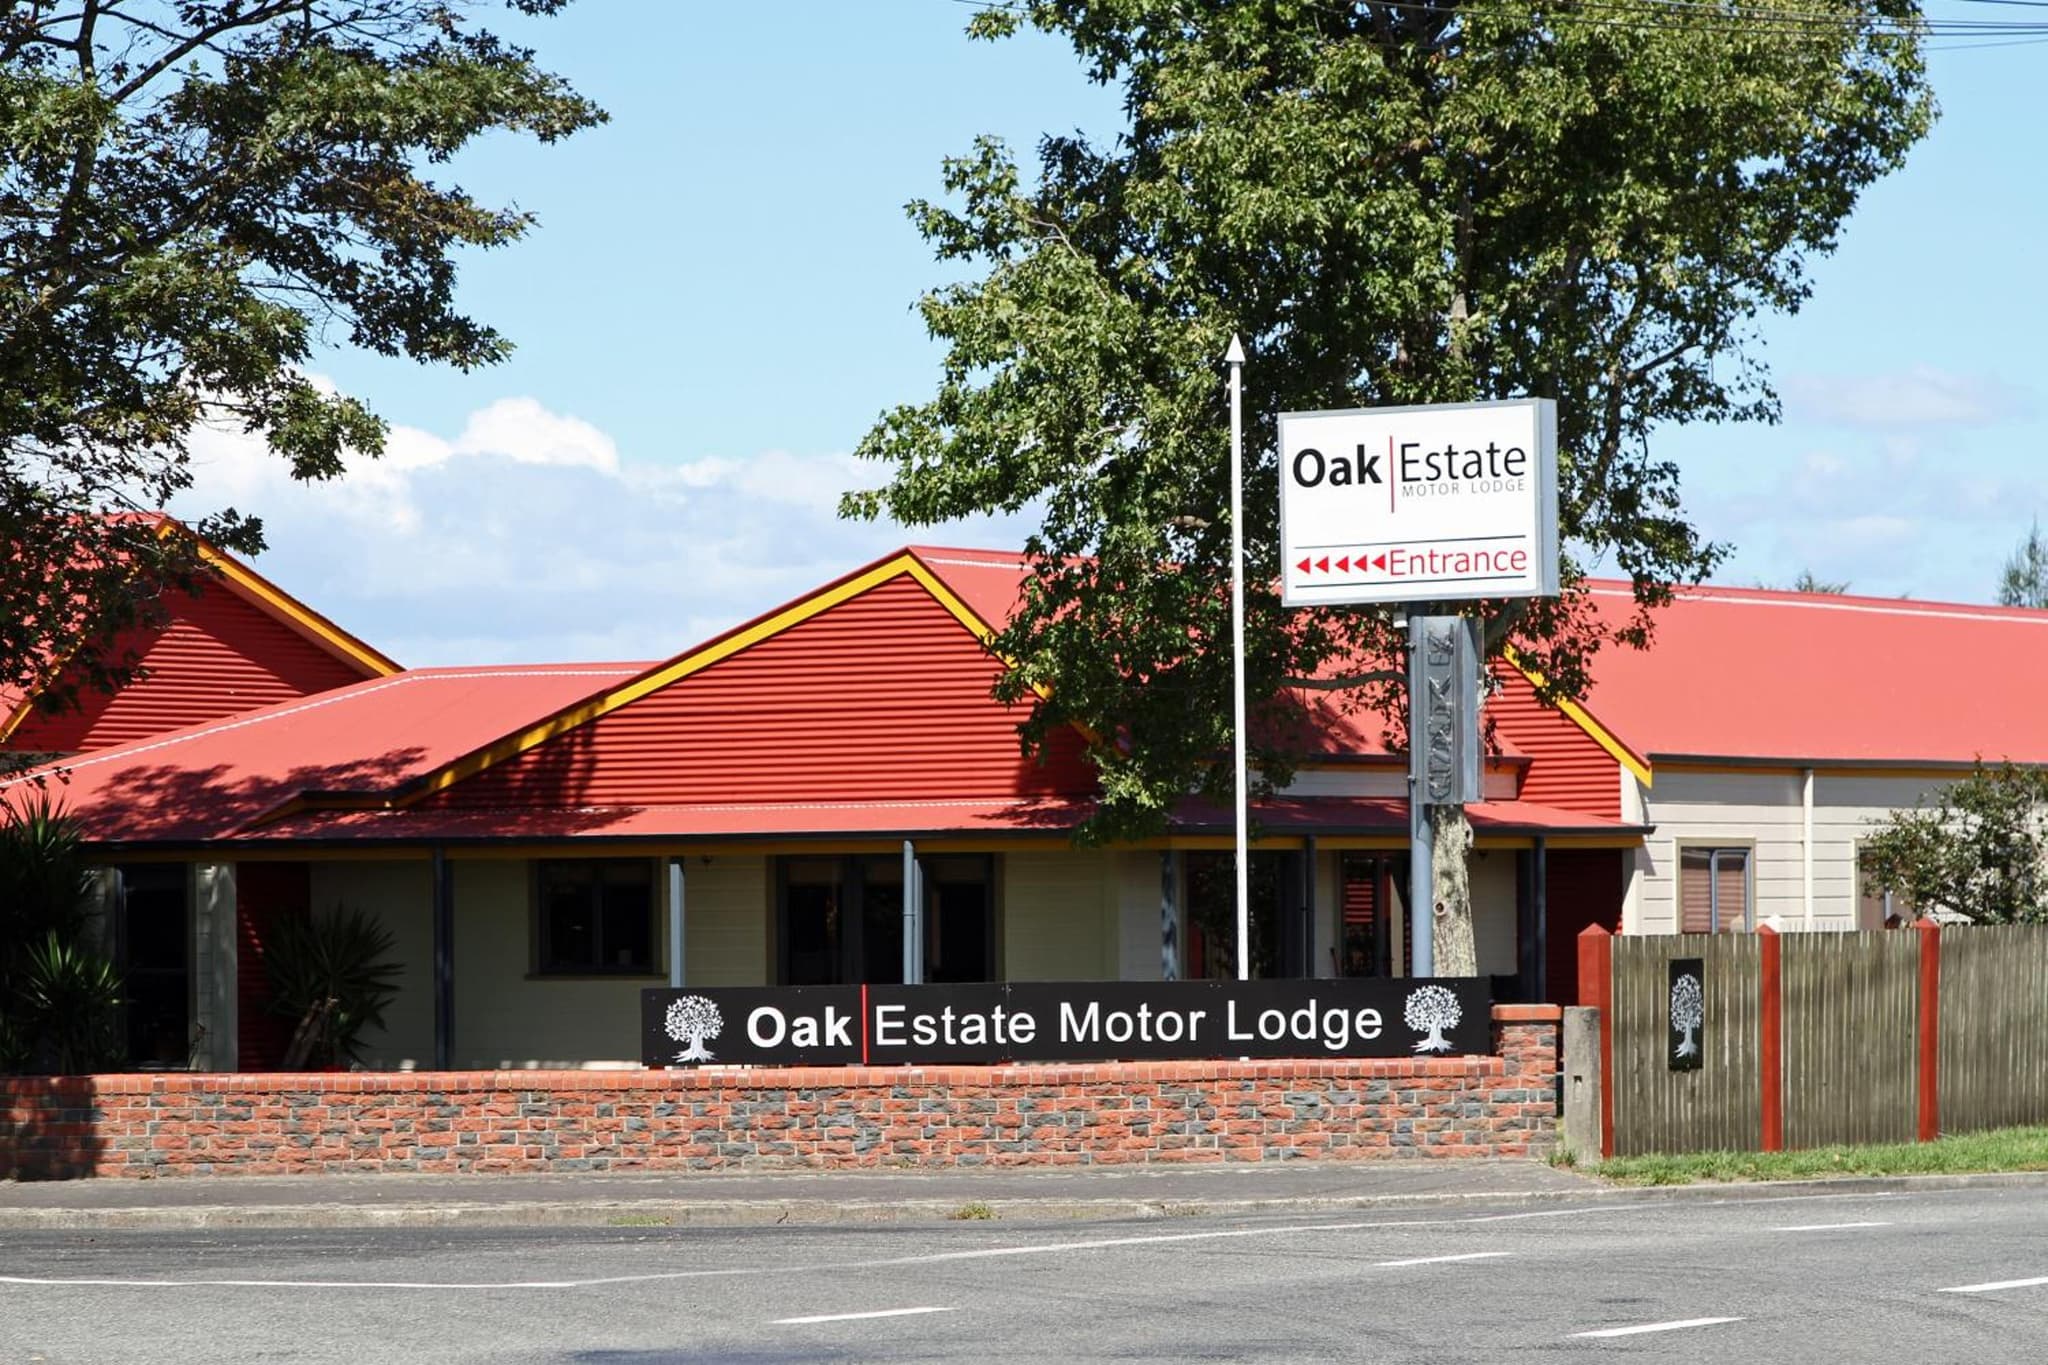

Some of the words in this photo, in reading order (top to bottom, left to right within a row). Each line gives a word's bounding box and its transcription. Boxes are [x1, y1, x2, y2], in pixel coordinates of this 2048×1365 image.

[1294, 444, 1383, 488] Oak
[1401, 442, 1526, 482] Estate
[1401, 481, 1460, 498] MOTOR
[1470, 478, 1525, 495] LODGE
[1389, 549, 1527, 577] Entrance
[746, 1006, 853, 1048] Oak
[875, 1004, 1036, 1046] Estate
[1060, 1001, 1206, 1043] Motor
[1227, 998, 1383, 1051] Lodge
